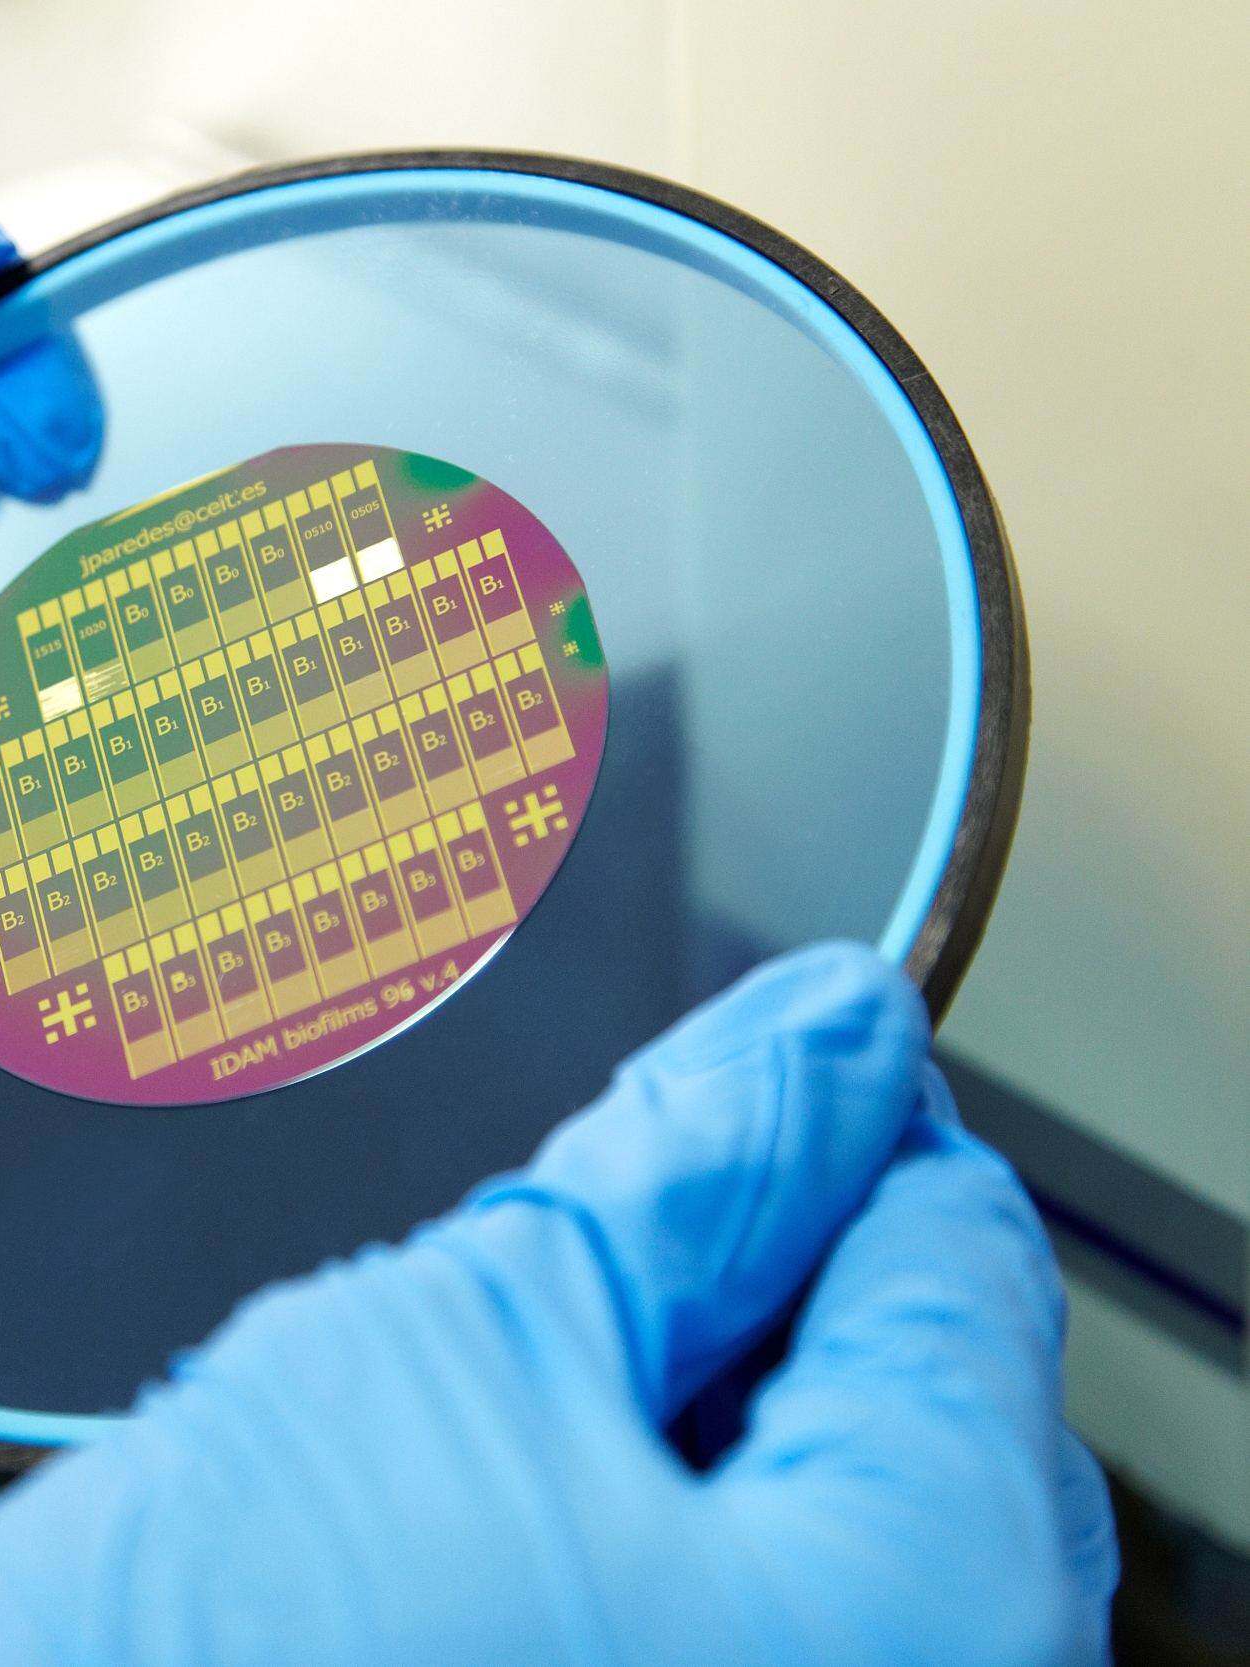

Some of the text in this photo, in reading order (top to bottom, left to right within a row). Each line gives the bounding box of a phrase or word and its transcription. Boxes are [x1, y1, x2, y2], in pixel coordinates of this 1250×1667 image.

[304, 520, 333, 540] 0510
[350, 499, 380, 519] 0505
[209, 1033, 279, 1081] IDAM
[281, 997, 379, 1050] biofilms
[380, 977, 416, 1009] 96
